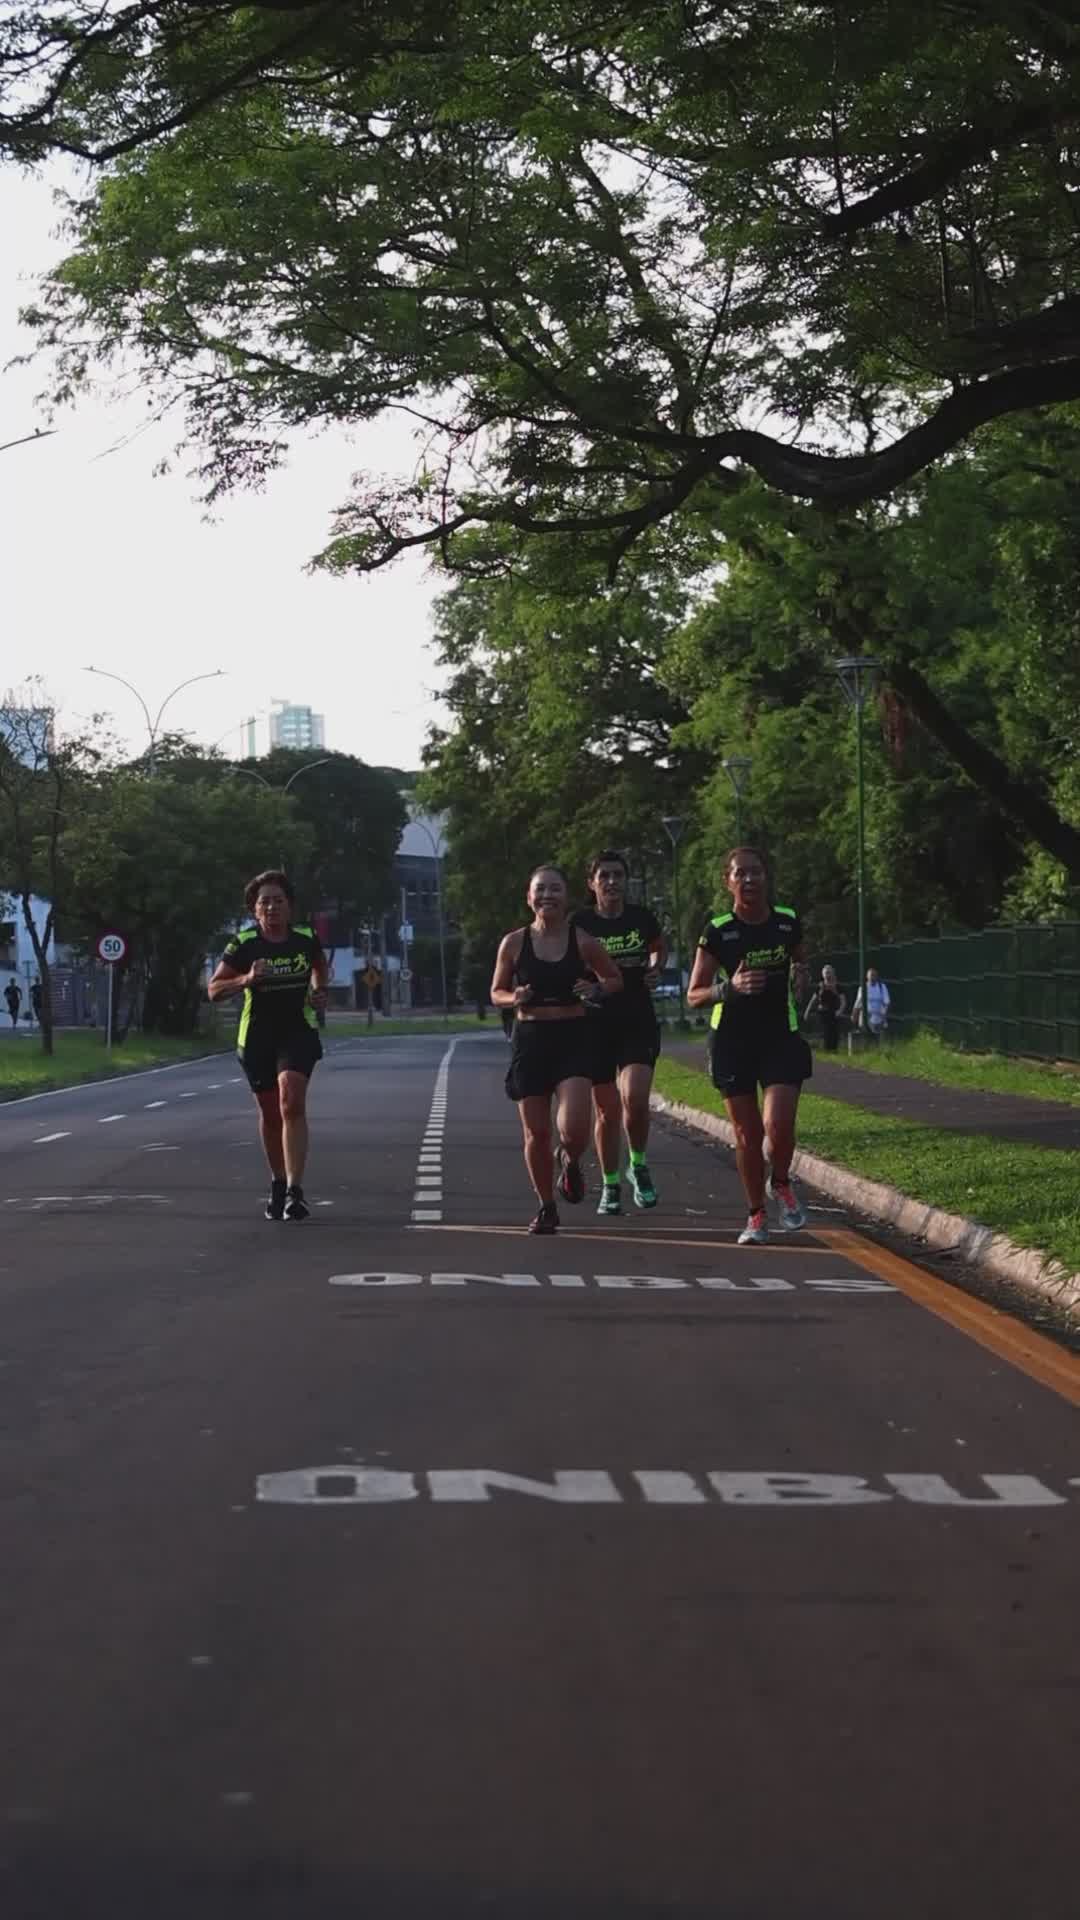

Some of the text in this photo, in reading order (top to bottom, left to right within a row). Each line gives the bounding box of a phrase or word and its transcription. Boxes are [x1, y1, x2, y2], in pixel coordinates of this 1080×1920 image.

[104, 938, 121, 953] 50
[329, 1272, 900, 1293] ONIBUS
[257, 1463, 1080, 1507] ONIBU
